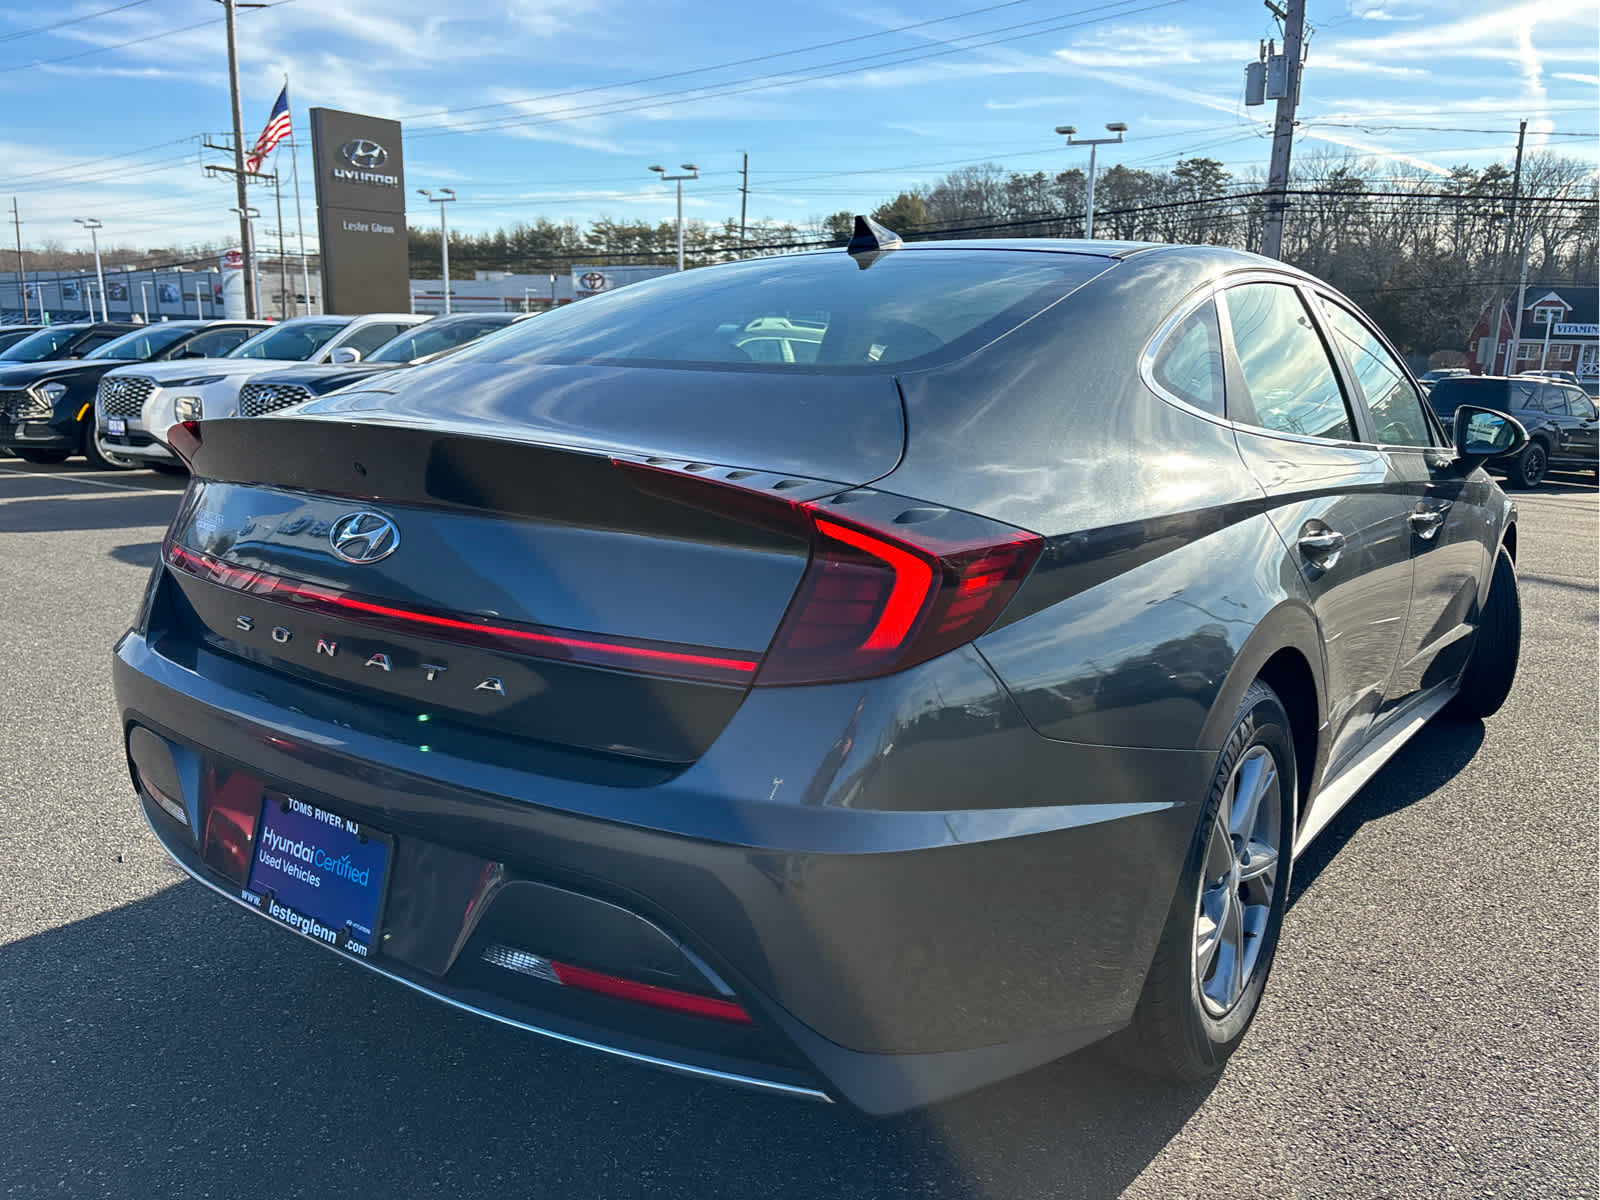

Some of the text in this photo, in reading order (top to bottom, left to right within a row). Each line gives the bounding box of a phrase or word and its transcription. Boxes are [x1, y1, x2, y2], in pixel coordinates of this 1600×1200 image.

[343, 220, 394, 234] Lester Glenn
[236, 615, 505, 696] SONATA
[288, 798, 313, 817] TOMS
[346, 819, 359, 835] NJ
[259, 849, 281, 869] Used
[282, 859, 321, 888] Vehicles
[241, 889, 262, 907] www.
[269, 900, 337, 944] lesterglenn
[344, 939, 368, 957] .com
